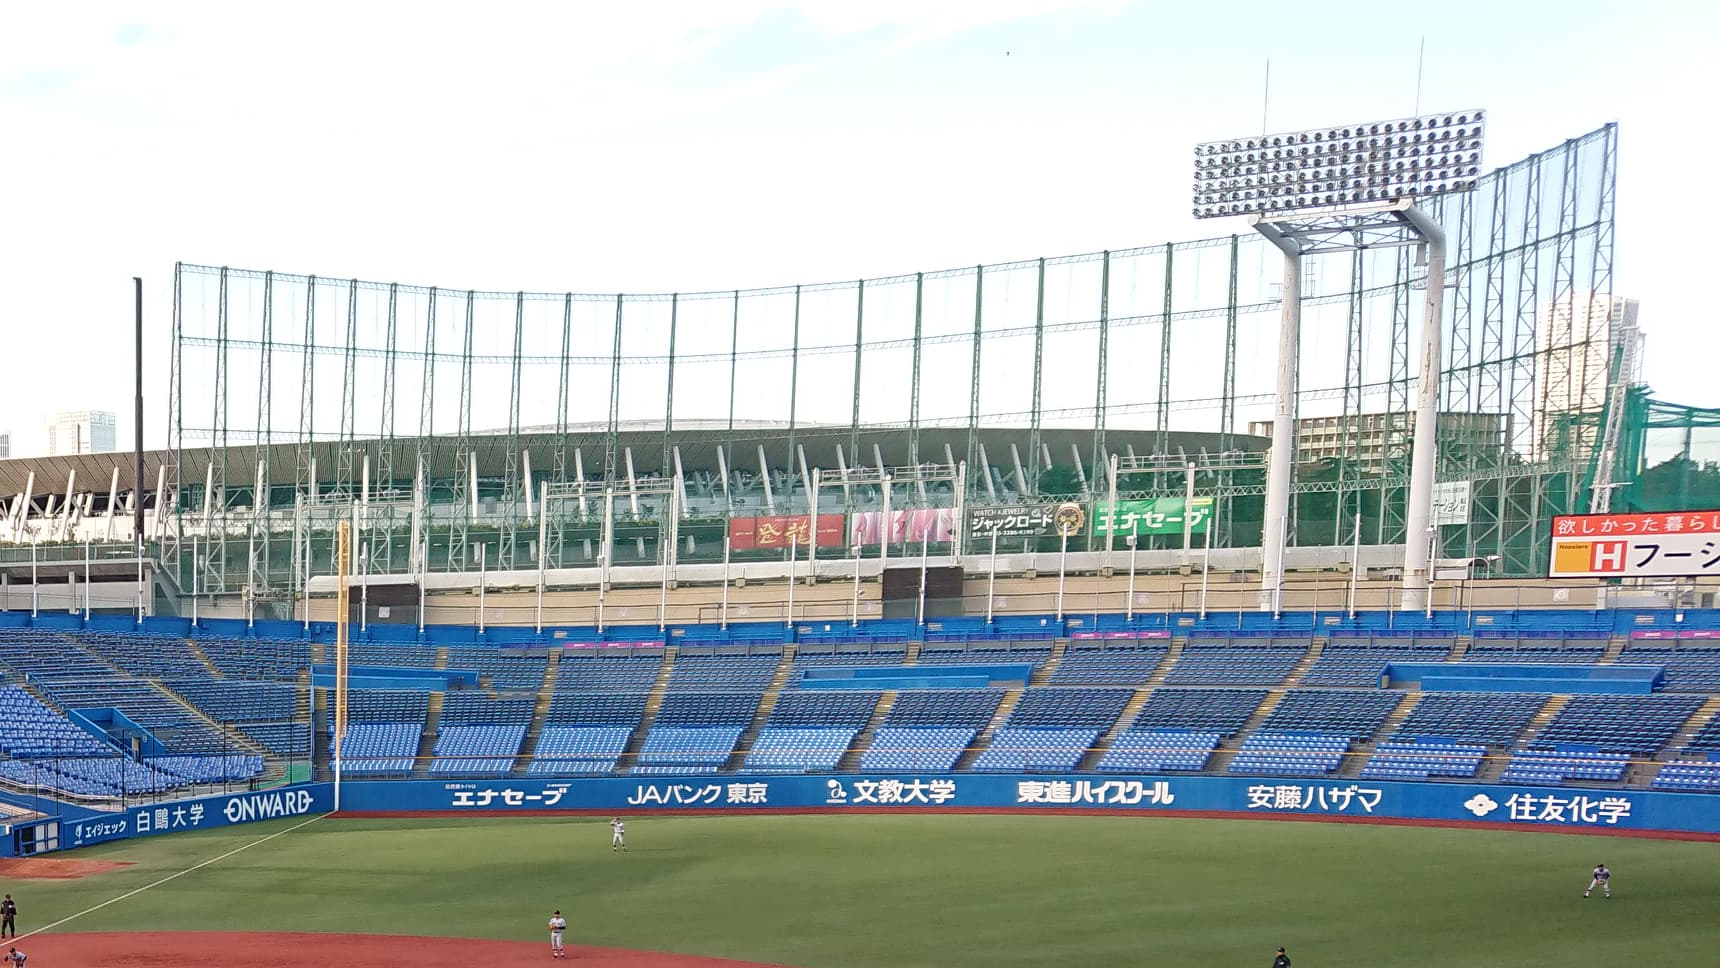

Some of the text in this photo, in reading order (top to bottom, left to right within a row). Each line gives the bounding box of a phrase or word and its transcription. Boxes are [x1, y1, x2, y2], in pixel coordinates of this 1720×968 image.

[972, 514, 1054, 531] ジャックロード
[1097, 508, 1209, 531] エナセーブ
[1594, 543, 1623, 571] H
[451, 787, 568, 806] エナセーブ
[627, 782, 769, 805] JAバンク 東京
[852, 778, 956, 804] 文教大学
[1016, 779, 1175, 806] 東進ハイスクール
[1246, 783, 1383, 814] 安藤ハザマ
[223, 789, 314, 823] ONWARD
[1504, 792, 1632, 824] 住友化学
[85, 819, 127, 839] エイジェック
